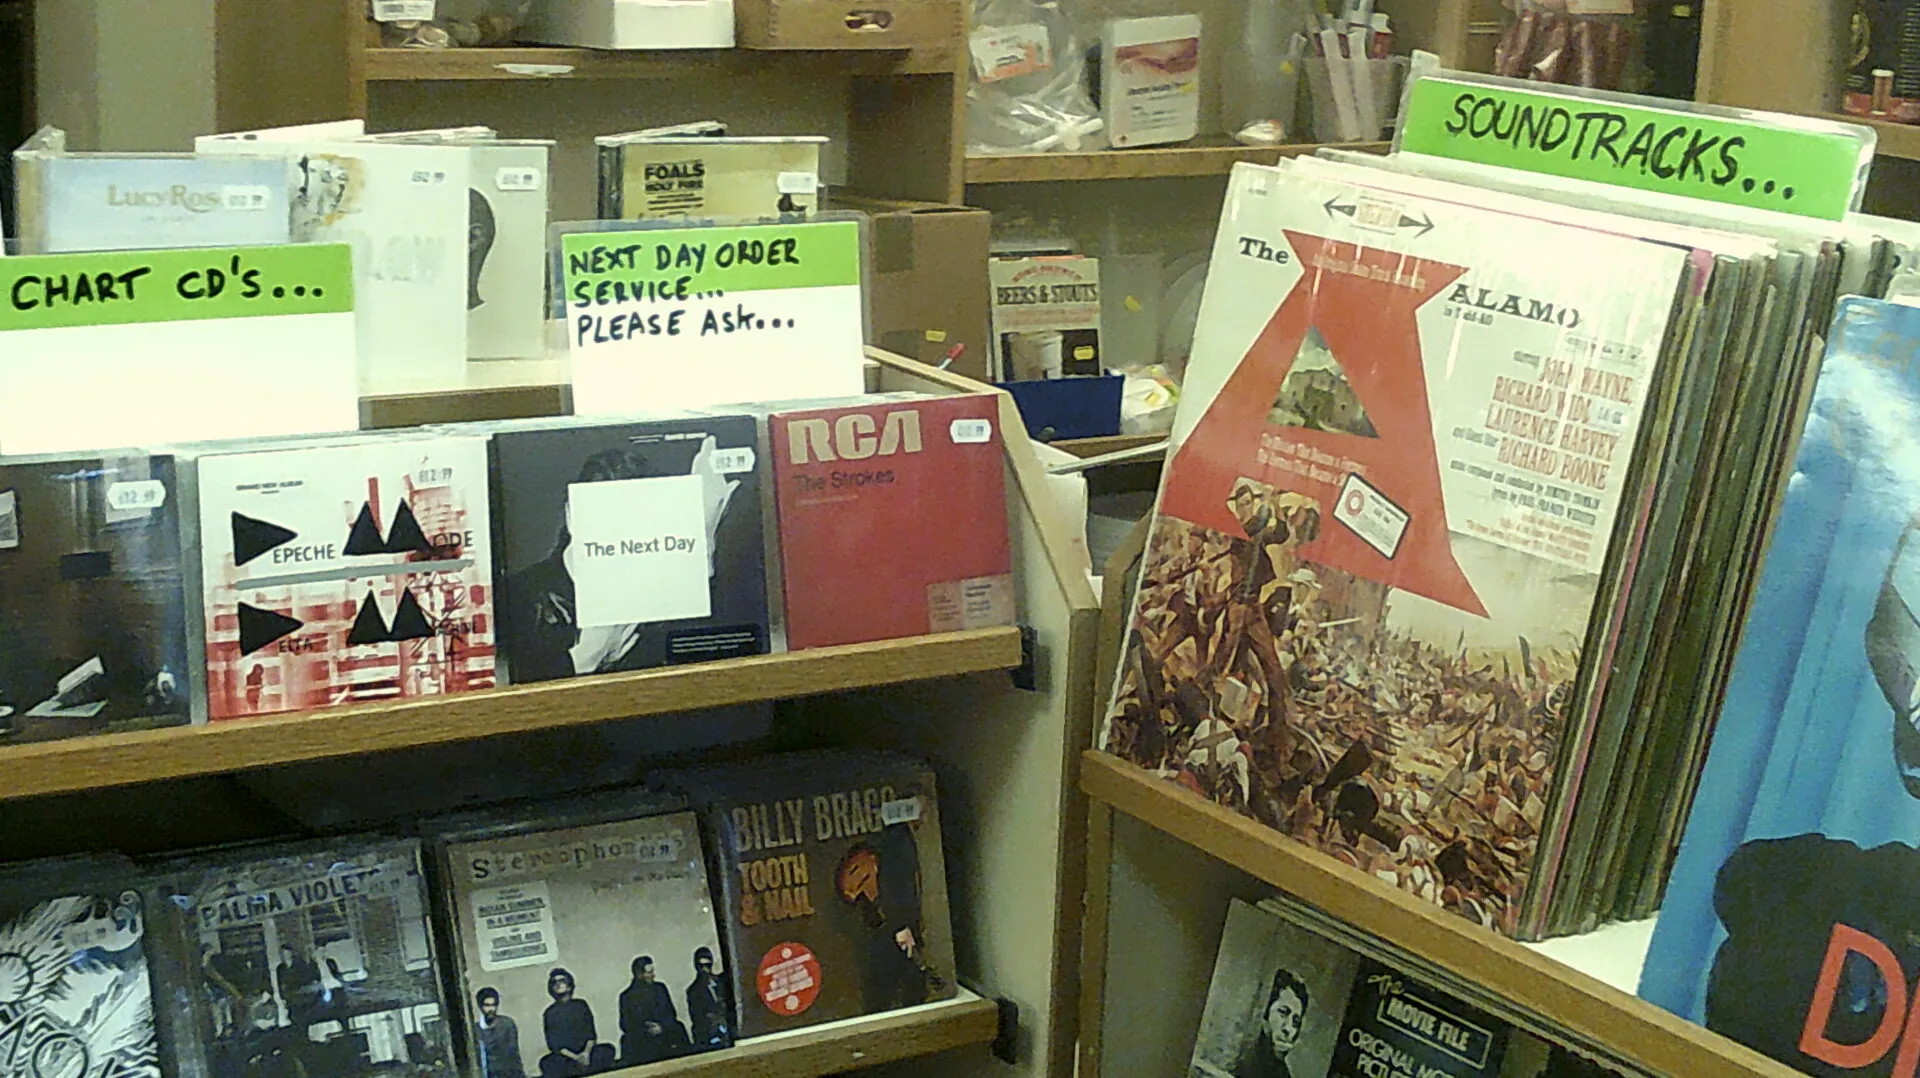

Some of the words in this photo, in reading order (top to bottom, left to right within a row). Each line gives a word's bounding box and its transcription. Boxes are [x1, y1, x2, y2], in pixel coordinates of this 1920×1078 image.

[1445, 93, 1796, 199] SOUNDTRACKS...
[645, 164, 705, 180] FOALS
[169, 184, 222, 213] Ros
[570, 243, 641, 276] NEXT
[655, 242, 706, 272] DAY
[715, 237, 800, 267] ORDER
[1239, 236, 1289, 264] The
[11, 267, 151, 310] CHART
[176, 256, 324, 300] CD'S...
[573, 278, 724, 308] SERVICE...
[1447, 283, 1581, 329] ALAMO
[577, 310, 685, 347] PLEASE
[1492, 375, 1553, 414] RICHARD
[787, 410, 923, 464] RCA
[1484, 403, 1560, 445] LAURENCE
[1559, 423, 1619, 462] HARVEY
[793, 474, 826, 492] The
[831, 468, 895, 489] Strokes
[1497, 436, 1558, 476] RICHARD
[1559, 453, 1609, 490] BOONE
[584, 541, 616, 558] The
[620, 537, 660, 554] Next
[664, 535, 696, 554] Day
[732, 800, 804, 852] BILLY
[737, 852, 810, 893] TOOTH
[200, 891, 283, 929] PALMA
[1387, 997, 1438, 1037] MOVIE
[1437, 1020, 1471, 1052] FILE
[1349, 1028, 1415, 1075] ORIGINAL
